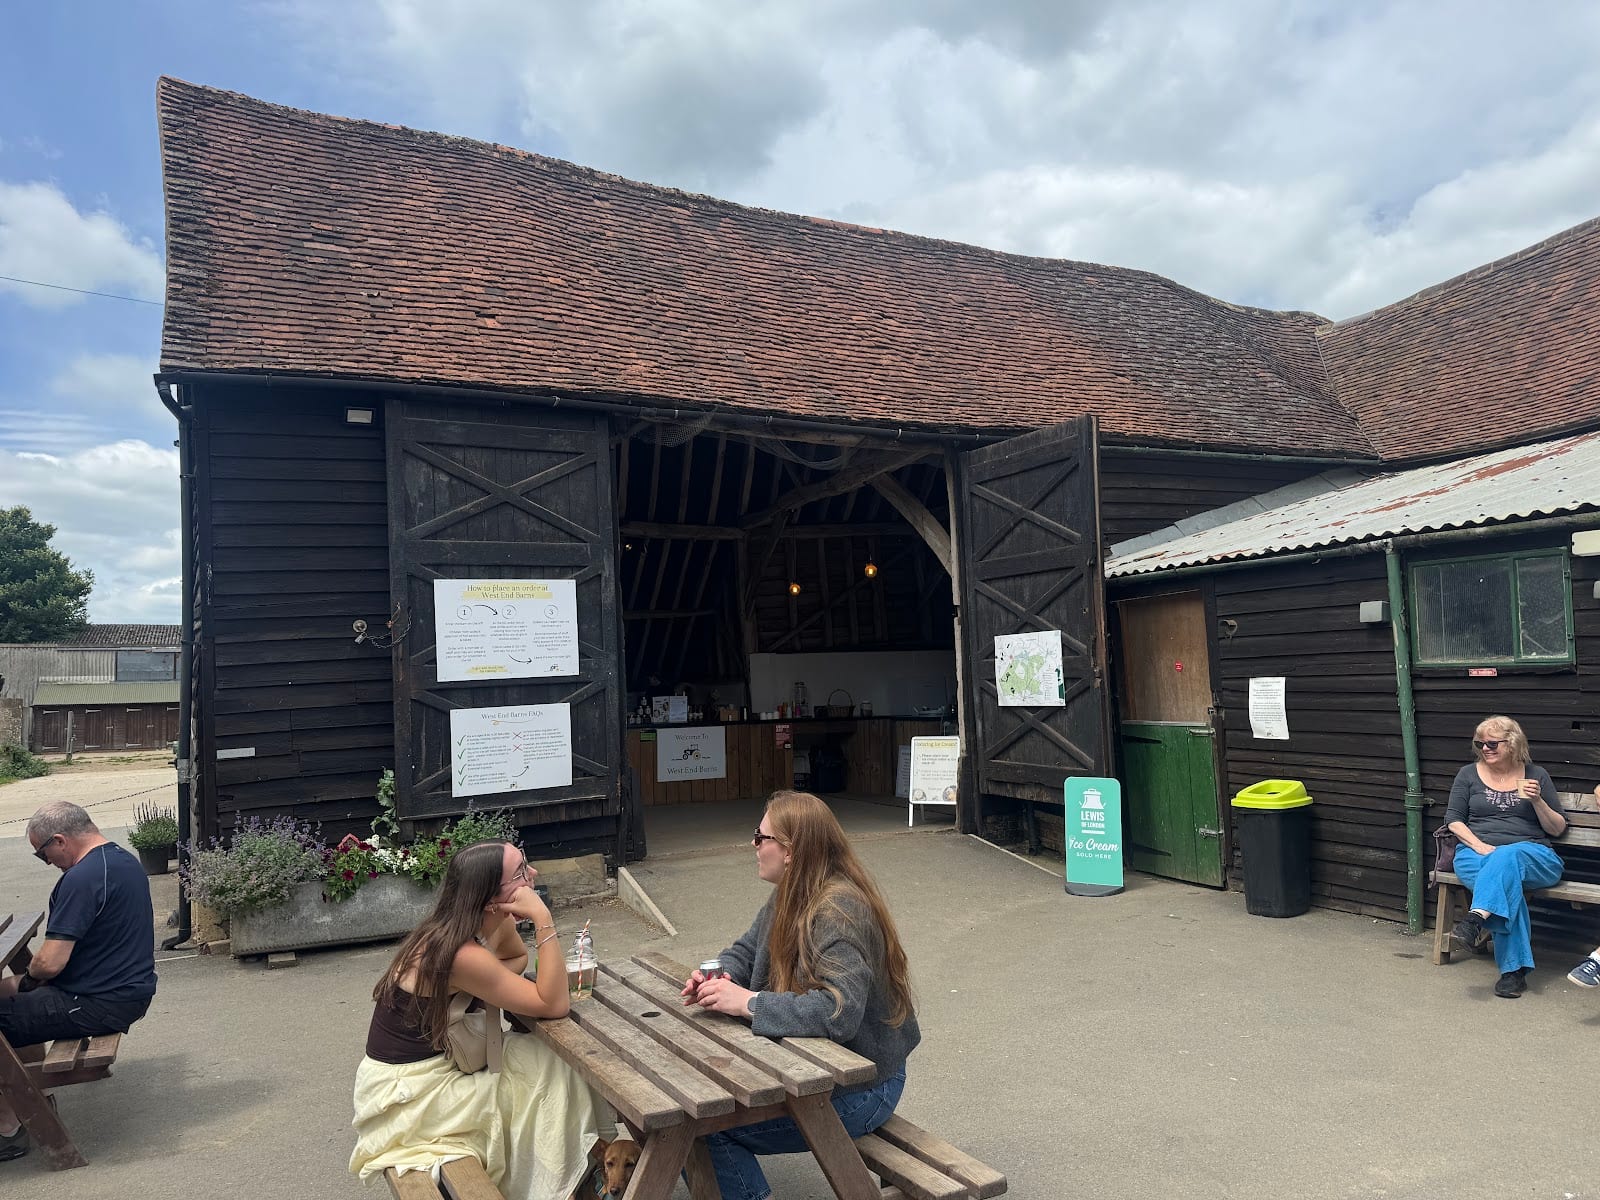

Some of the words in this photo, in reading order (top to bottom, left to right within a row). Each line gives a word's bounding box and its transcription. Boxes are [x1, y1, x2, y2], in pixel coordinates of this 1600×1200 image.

[467, 584, 482, 592] How
[492, 584, 510, 593] place
[522, 584, 541, 592] order
[528, 710, 543, 718] FAQs
[667, 767, 684, 775] West
[685, 766, 698, 774] End
[699, 765, 718, 773] Barns
[1081, 810, 1105, 822] LEWIS
[1069, 835, 1084, 850] Ice
[1085, 838, 1120, 852] Cream
